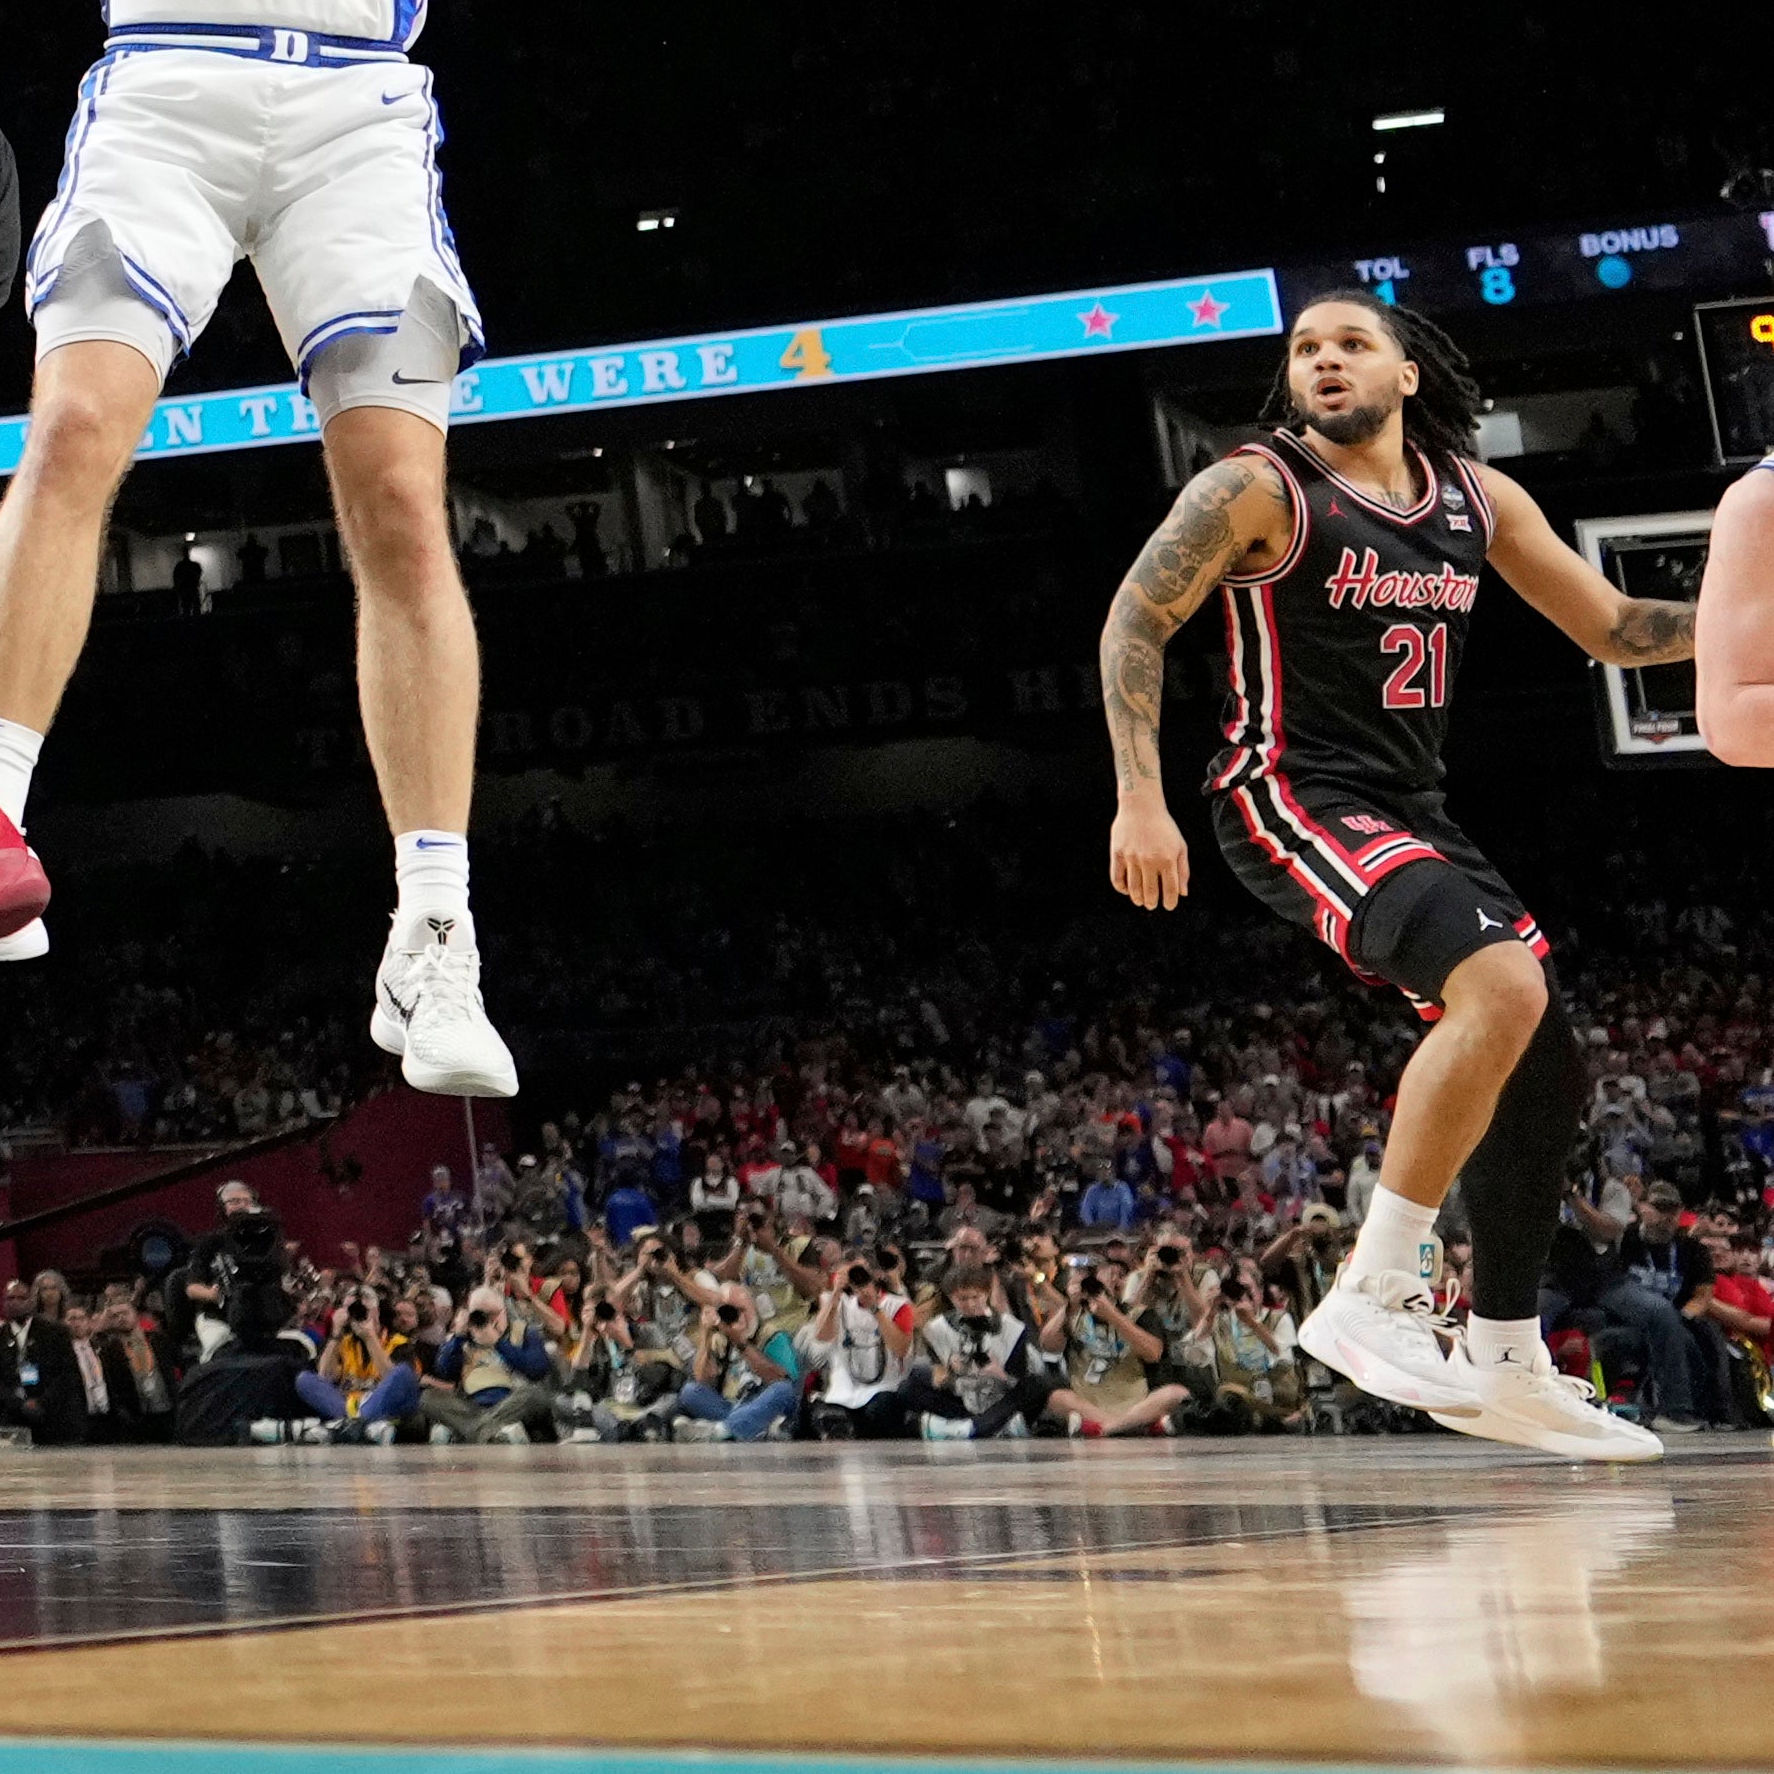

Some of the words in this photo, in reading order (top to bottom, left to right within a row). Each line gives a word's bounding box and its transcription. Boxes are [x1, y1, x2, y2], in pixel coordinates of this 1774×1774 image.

[273, 29, 309, 61] D
[1355, 257, 1409, 283] TOL
[1466, 243, 1520, 270] FLS
[1579, 224, 1680, 259] BONUS
[1480, 268, 1516, 306] 8
[521, 344, 738, 405] WERE
[778, 328, 832, 381] 4
[1324, 546, 1480, 614] Houston
[1382, 623, 1447, 708] 21
